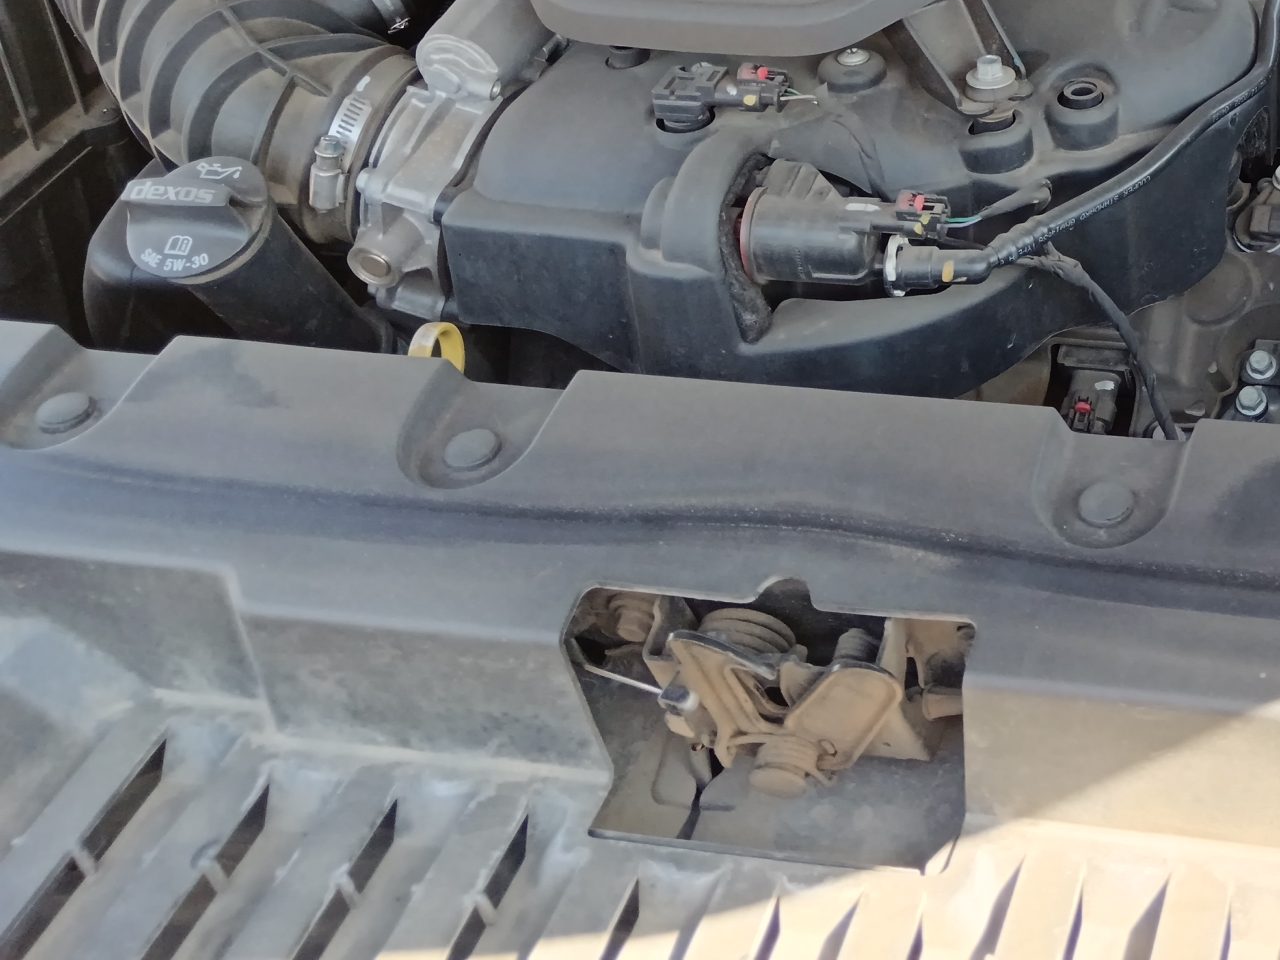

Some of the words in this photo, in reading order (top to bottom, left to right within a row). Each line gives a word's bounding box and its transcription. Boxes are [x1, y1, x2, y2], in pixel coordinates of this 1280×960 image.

[129, 181, 217, 204] dexos
[140, 248, 163, 268] SAE
[163, 252, 210, 271] 5W-30
